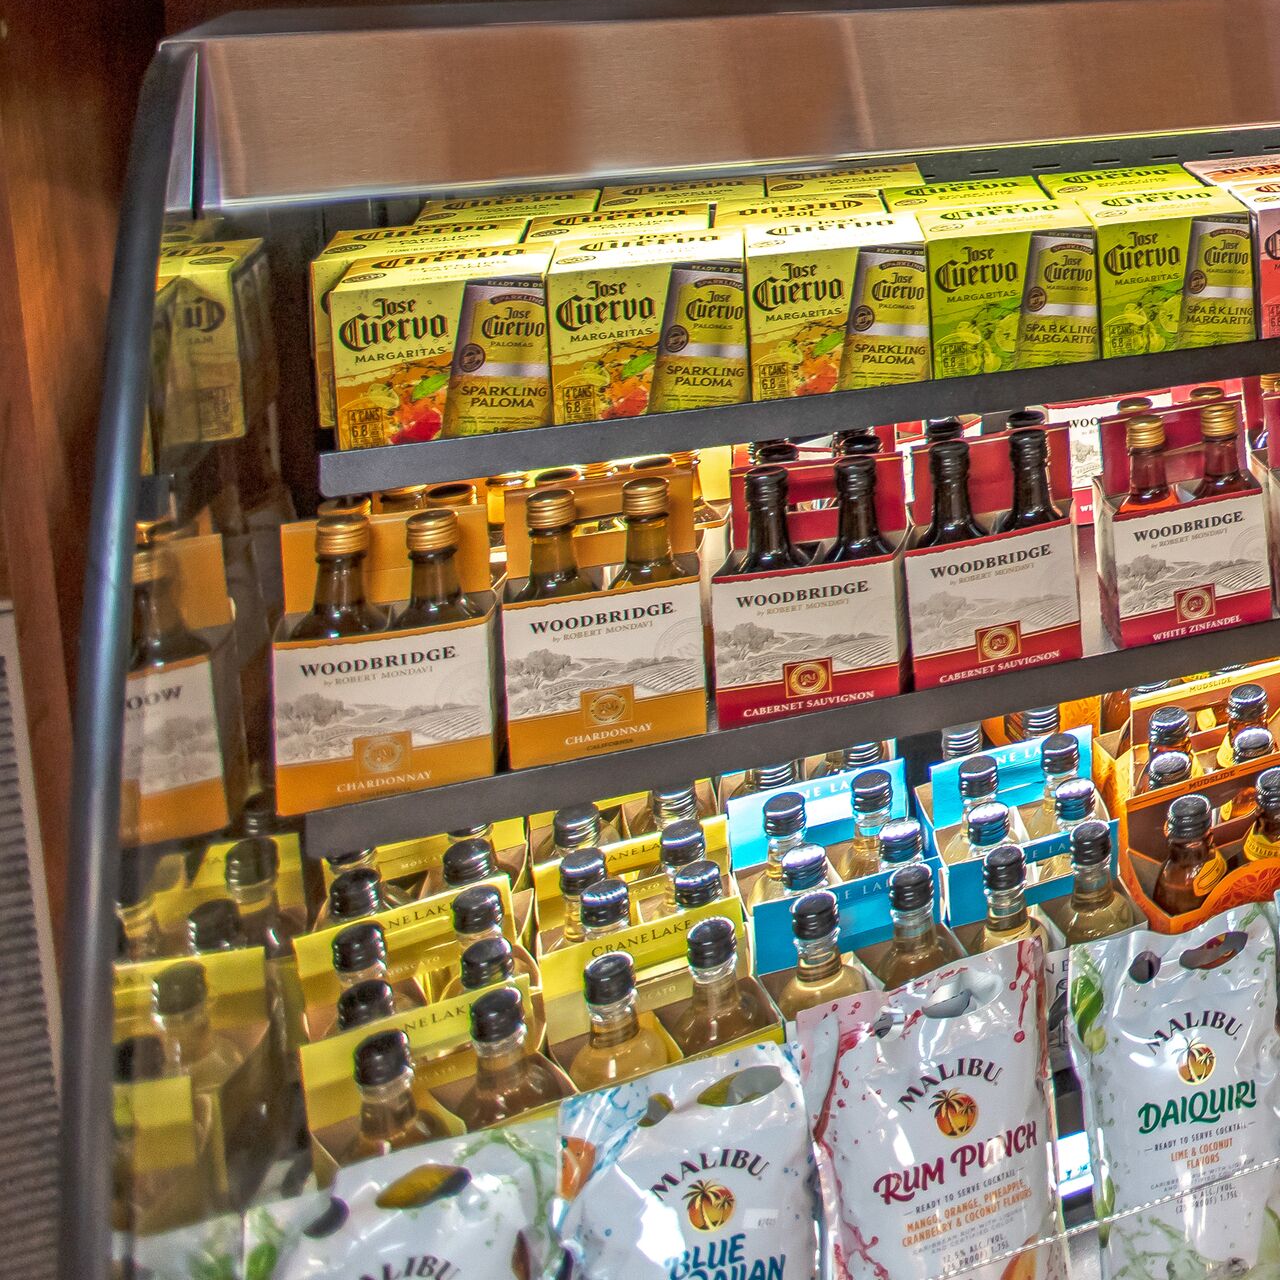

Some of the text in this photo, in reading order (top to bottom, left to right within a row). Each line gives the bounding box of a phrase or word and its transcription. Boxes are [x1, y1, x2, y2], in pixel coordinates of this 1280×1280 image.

[934, 257, 1018, 293] Cuervo
[1103, 243, 1180, 277] Cuervo
[587, 280, 626, 299] Jose
[752, 276, 843, 311] Cuervo
[374, 298, 415, 319] Jose
[555, 291, 655, 331] Cuervo
[766, 308, 842, 322] MARGARITAS
[339, 312, 448, 351] Cuervo
[570, 327, 653, 343] MARGARITAS
[355, 346, 446, 363] MARGARITAS
[461, 384, 547, 397] SPARKLING
[471, 396, 534, 409] PALOMA
[1134, 512, 1242, 542] WOODBRIDGE
[930, 544, 1051, 578] WOODBRIDGE
[737, 581, 869, 608] WOODBRIDGE
[530, 602, 674, 635] WOODBRIDGE
[1153, 616, 1241, 641] WHITE ZINFANDEL
[301, 646, 456, 678] WOODBRIDGE
[335, 672, 377, 685] ROBERT
[381, 666, 433, 679] MONDAVI
[744, 690, 874, 718] CABERNET SAUVIGNON
[336, 770, 432, 793] CHARDONNAY
[592, 920, 691, 957] CRANE LAKE
[1148, 1011, 1243, 1054] MALIBU
[899, 1058, 1001, 1111] MALIBU
[1138, 1081, 1256, 1134] DAIQUIRI
[1155, 1122, 1247, 1152] READY TO SERVE COCKTAIL
[874, 1122, 1037, 1204] RUM PUNCH
